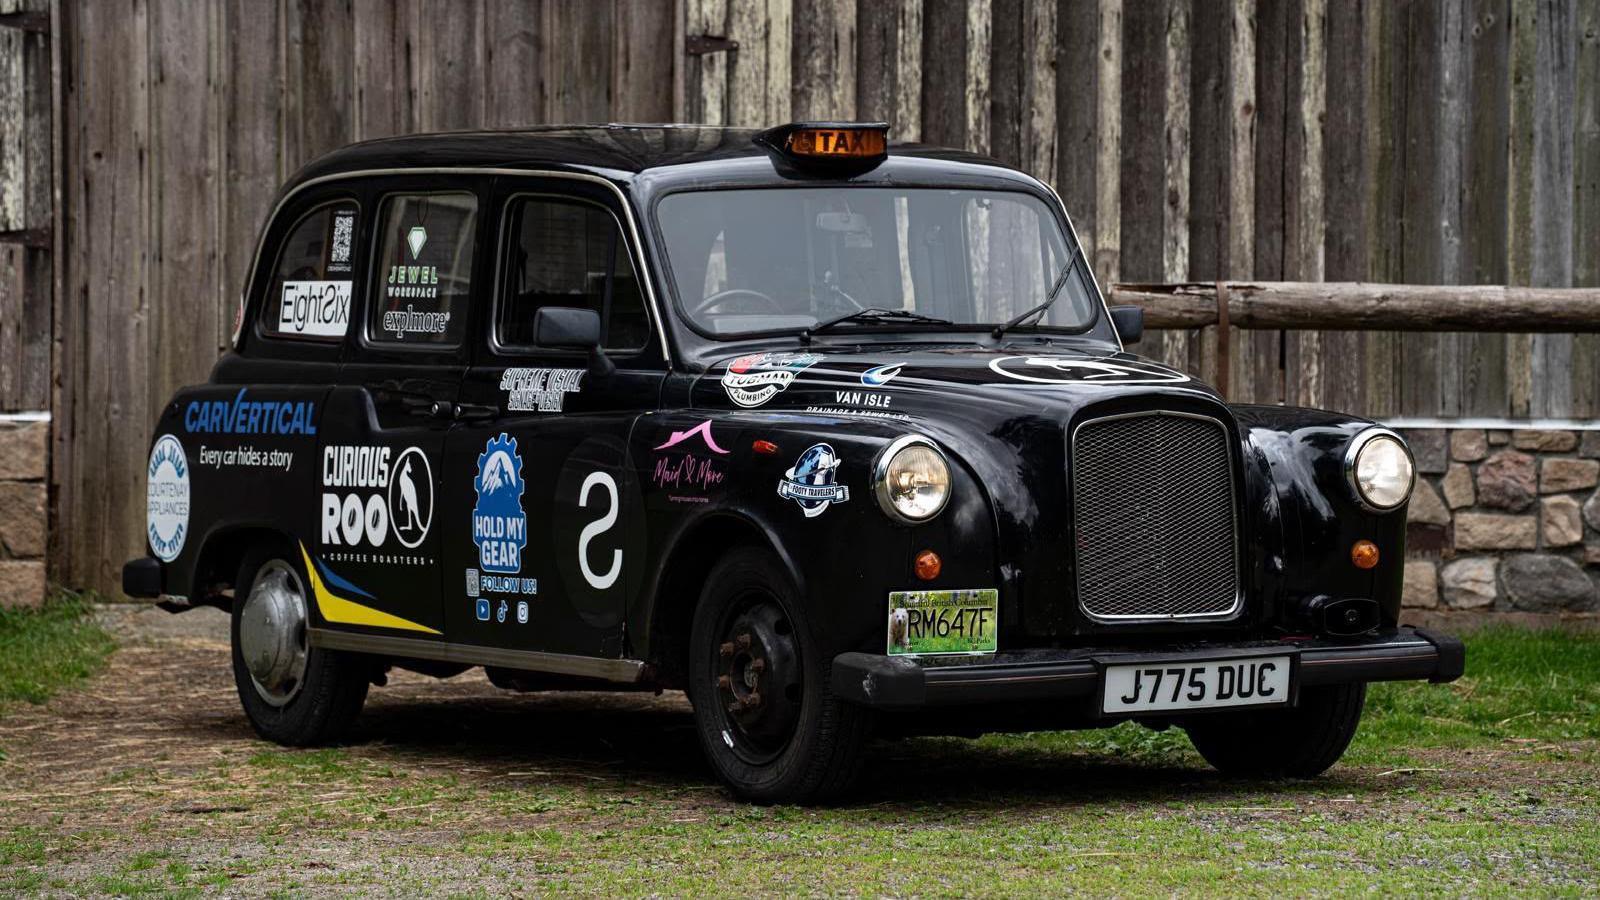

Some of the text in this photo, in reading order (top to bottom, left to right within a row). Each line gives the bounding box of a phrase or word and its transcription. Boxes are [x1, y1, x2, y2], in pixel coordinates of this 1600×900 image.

[819, 132, 872, 154] TAXI
[388, 266, 438, 284] JEWEL
[387, 287, 437, 298] WORKSPACE
[730, 373, 789, 385] TUGMAN
[733, 388, 772, 401] PLUMBING
[836, 391, 892, 408] VAN ISLE
[184, 387, 316, 435] CARVERTICAL
[806, 406, 849, 415] DRAINAGE
[199, 445, 293, 472] Every car hides a story
[323, 446, 391, 487] CURIOUS
[792, 485, 835, 497] FOOTY TRAVELERS
[321, 493, 388, 547] ROO
[475, 516, 524, 540] HOLD MY
[330, 553, 425, 565] COFFEE ROASTERS
[482, 541, 518, 567] GEAR
[480, 575, 537, 595] FOLLOW US!
[906, 607, 993, 638] RM647F
[1121, 662, 1276, 704] J775 DUC
